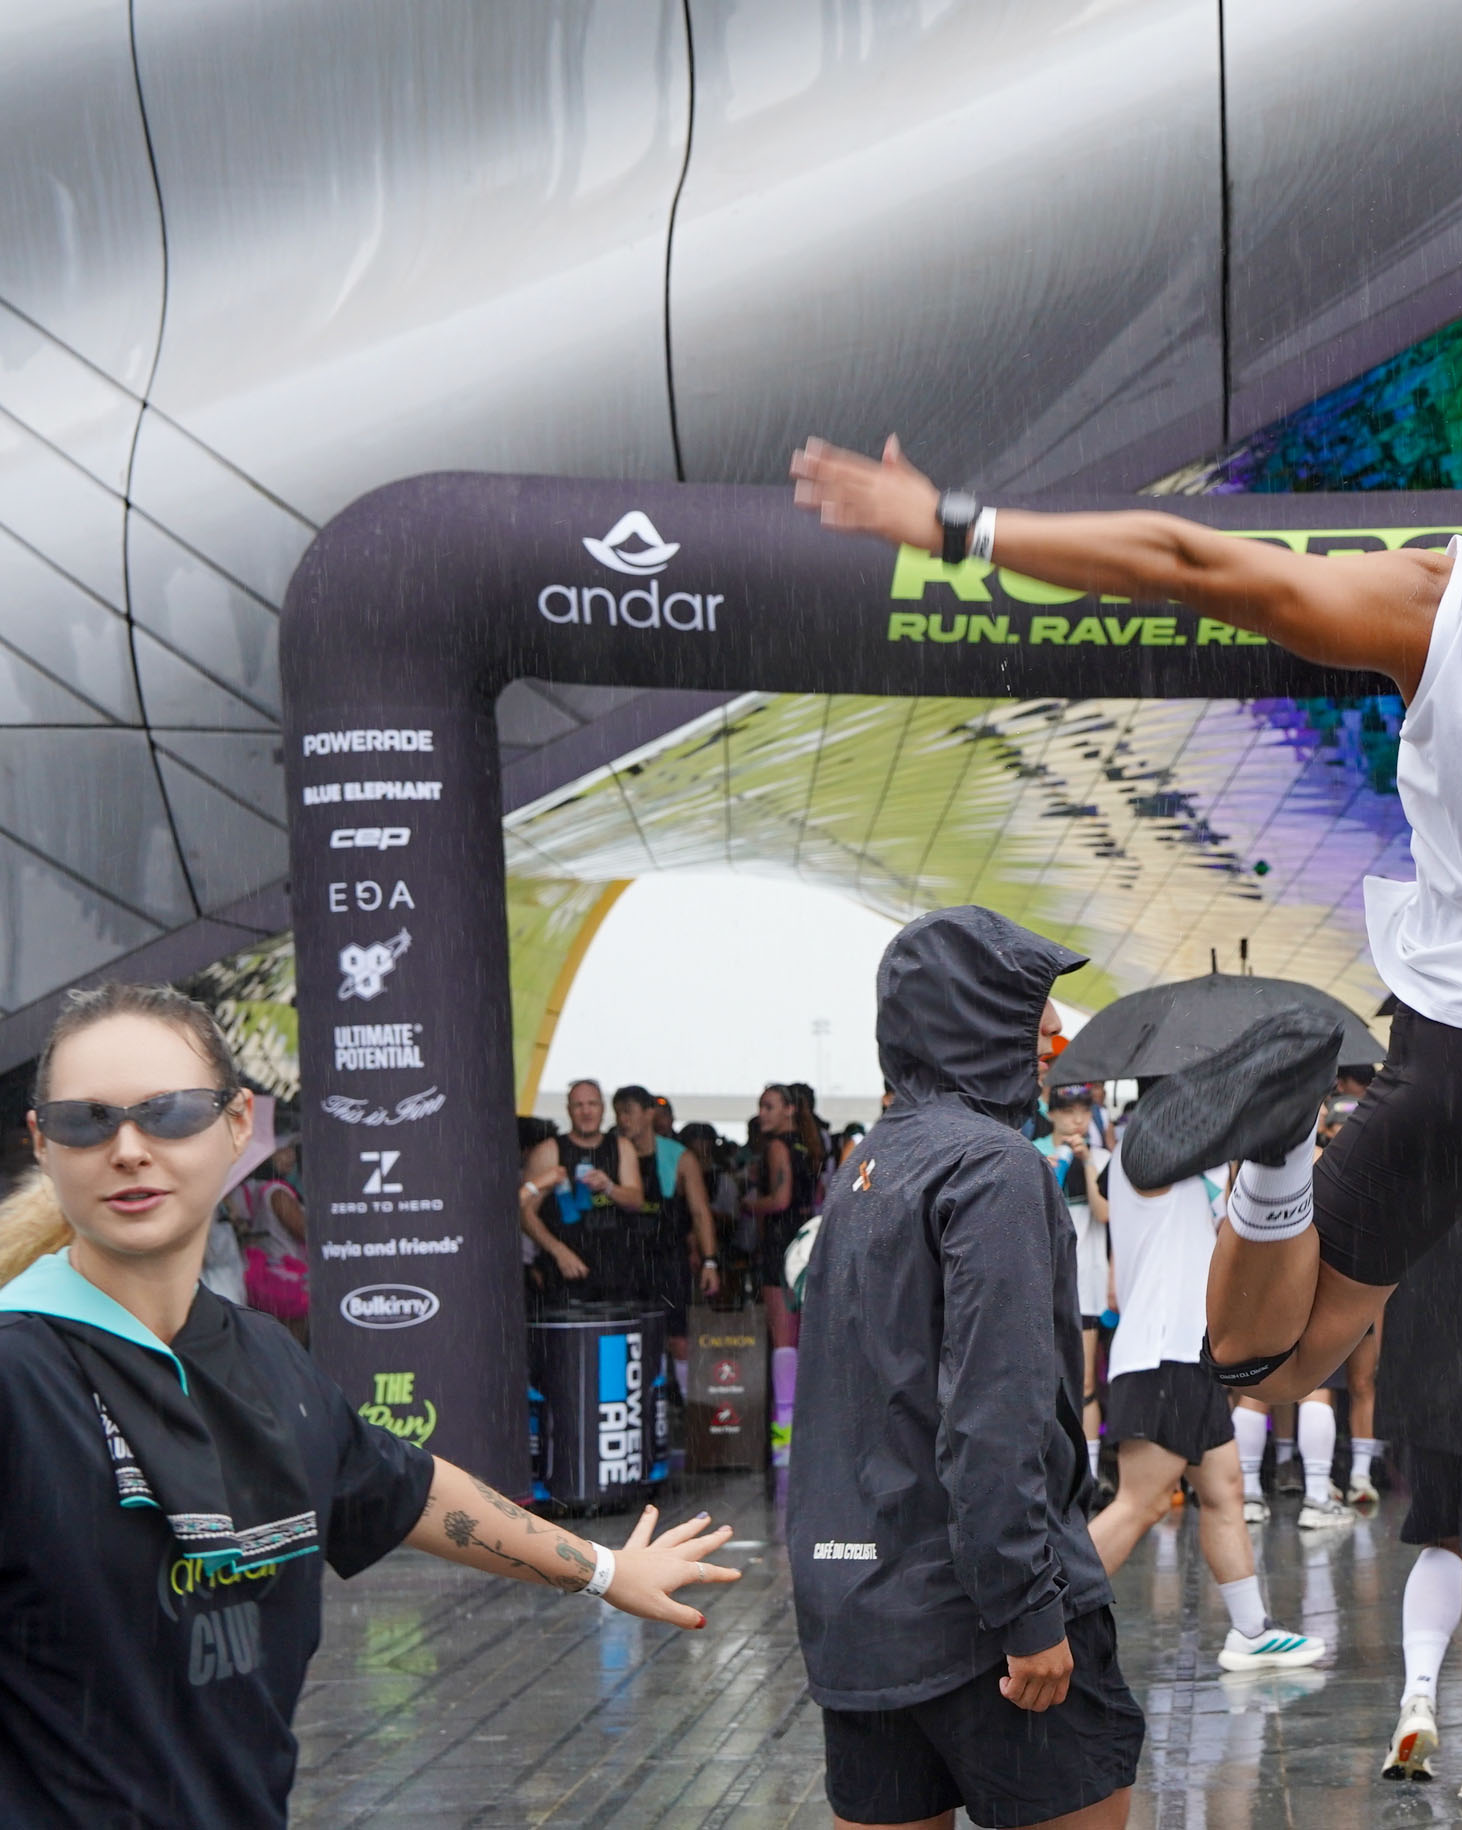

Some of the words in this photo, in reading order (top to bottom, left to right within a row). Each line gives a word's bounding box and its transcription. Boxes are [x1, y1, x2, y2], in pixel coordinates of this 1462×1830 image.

[538, 578, 725, 632] andar
[887, 611, 1021, 644] RUN.
[1028, 615, 1188, 646] RAVE.
[303, 729, 434, 757] POWERADE
[303, 783, 342, 806] BLUE
[343, 781, 443, 802] ELEPHANT
[335, 1046, 424, 1071] POTENTIAL
[330, 1202, 368, 1215] ZERO
[372, 1201, 394, 1213] TO
[397, 1199, 444, 1212] HERO
[363, 1238, 397, 1257] and
[374, 1371, 415, 1404] THE
[626, 1332, 643, 1483] POWER
[599, 1402, 627, 1485] ADE
